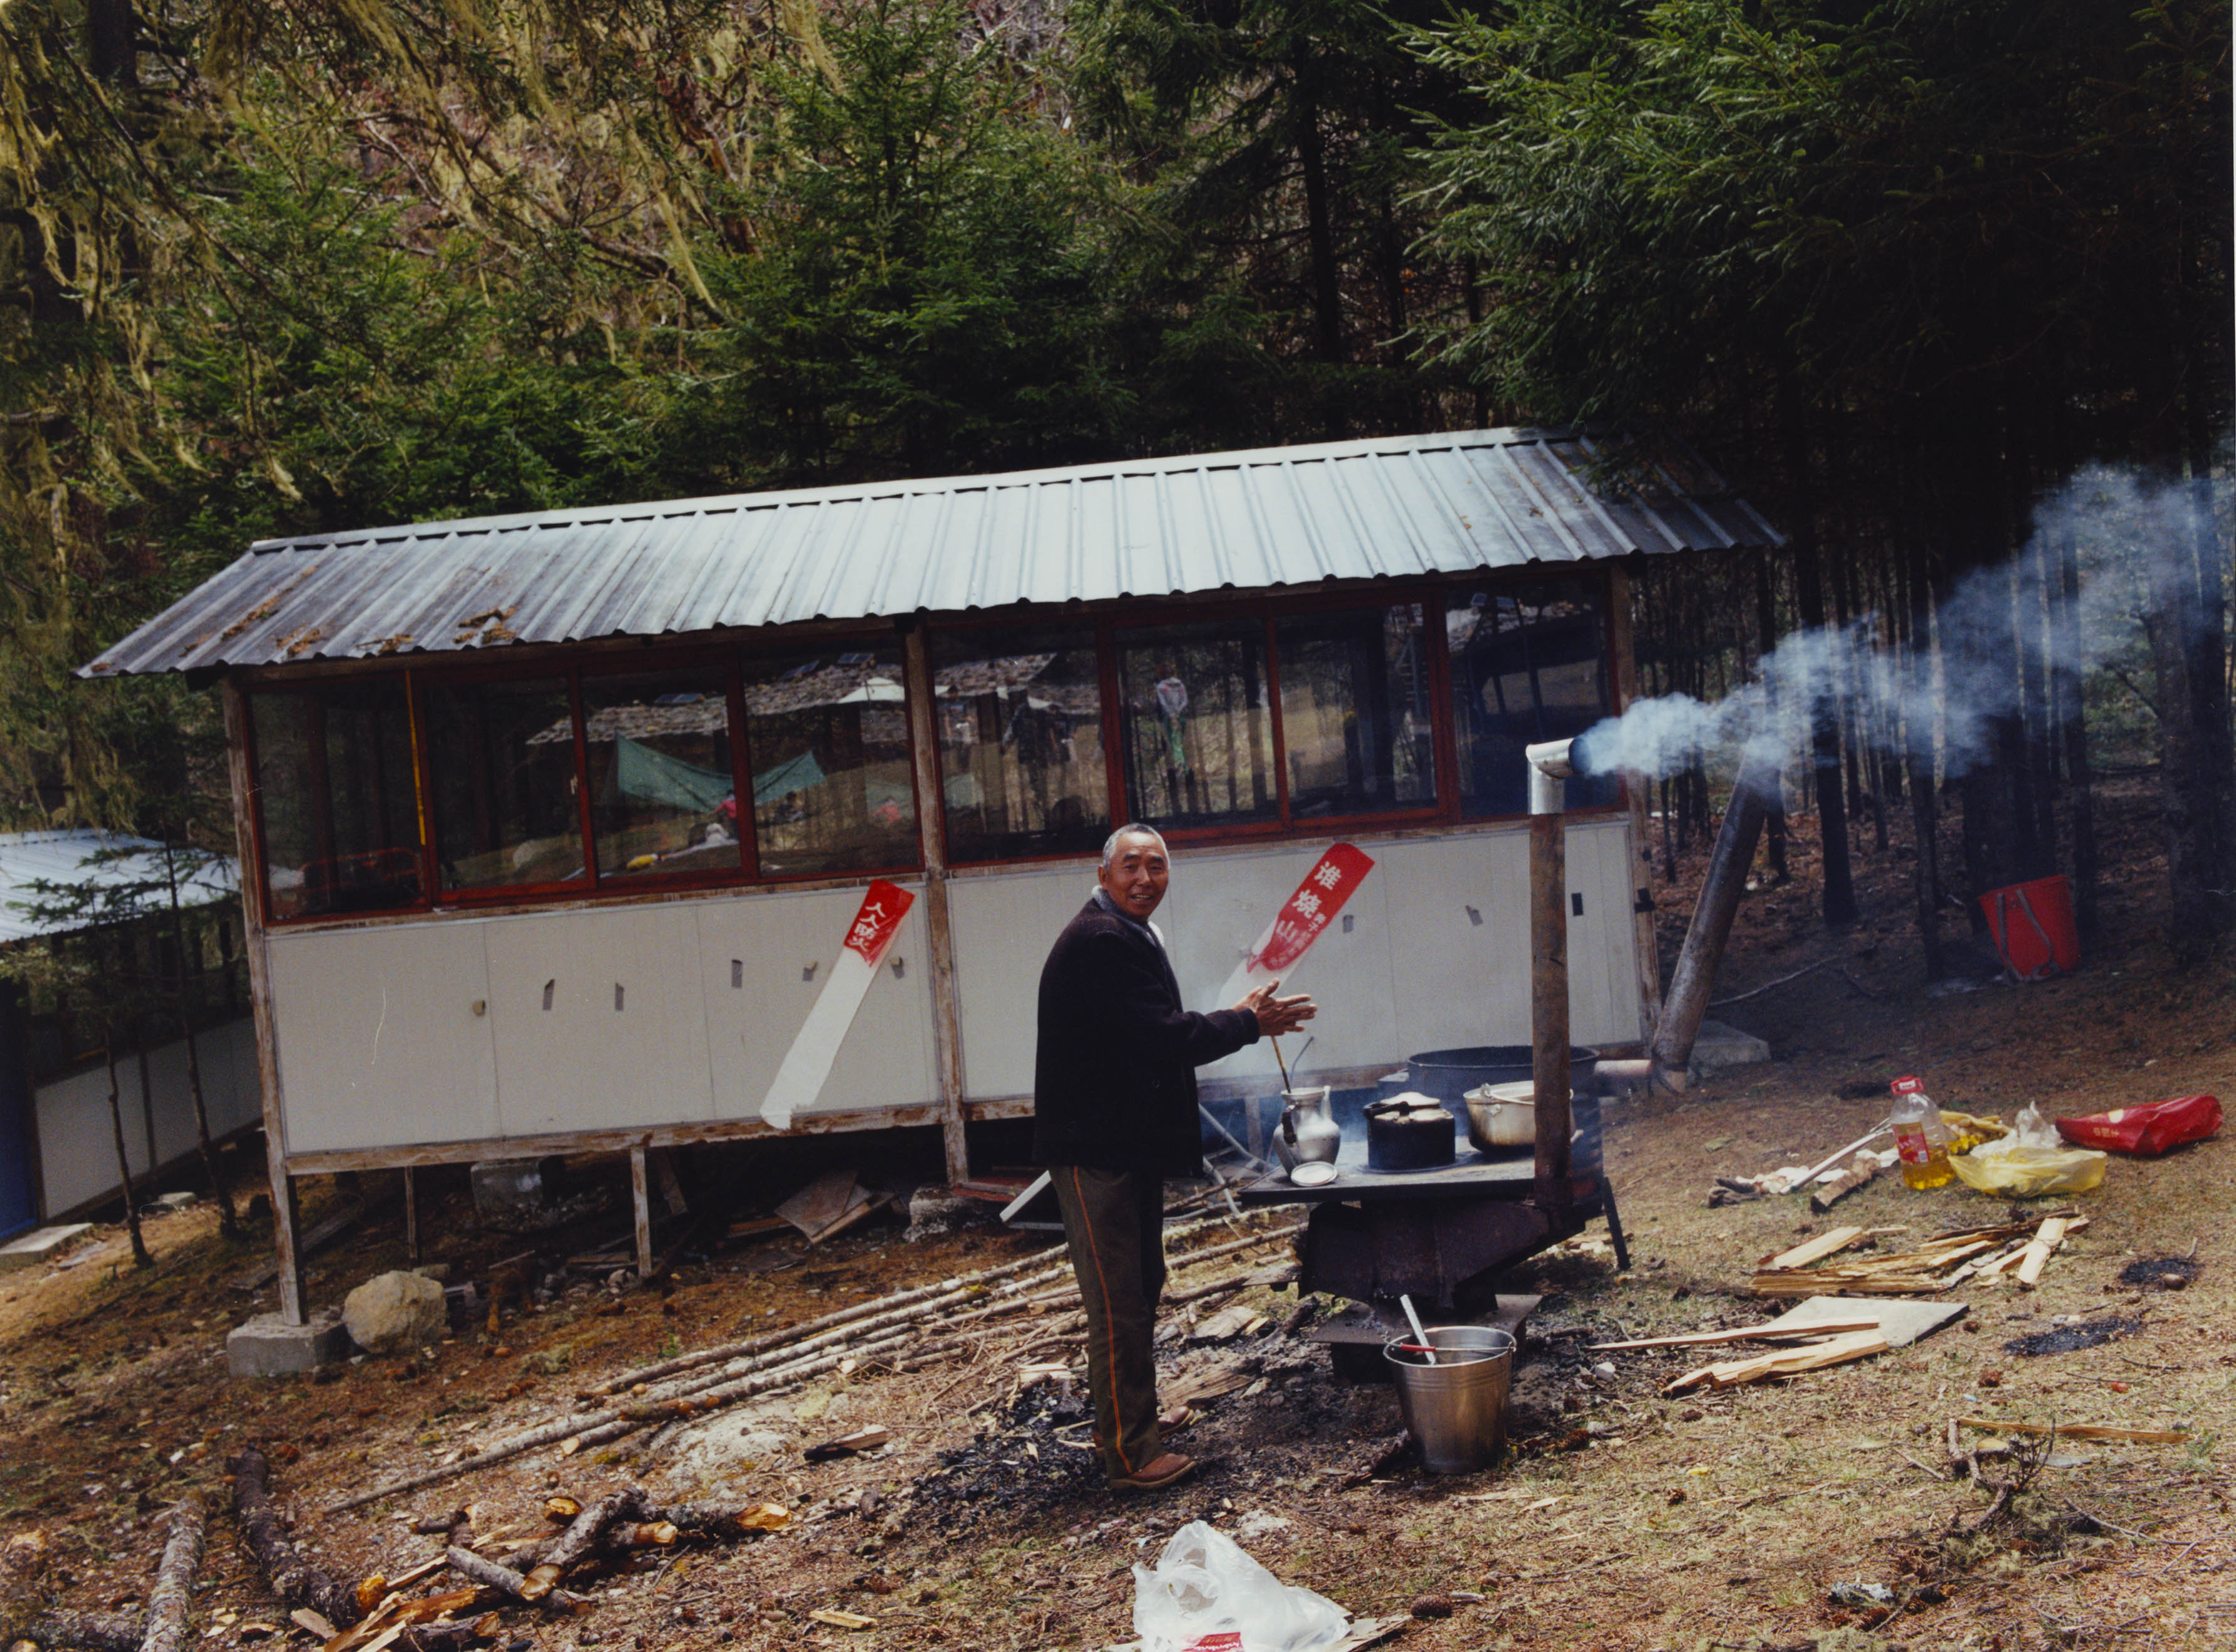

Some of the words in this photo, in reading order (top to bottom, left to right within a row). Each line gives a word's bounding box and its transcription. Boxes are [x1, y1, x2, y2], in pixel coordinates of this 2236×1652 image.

[849, 903, 886, 952] 人人防火
[1276, 862, 1341, 942] 谁烧山
